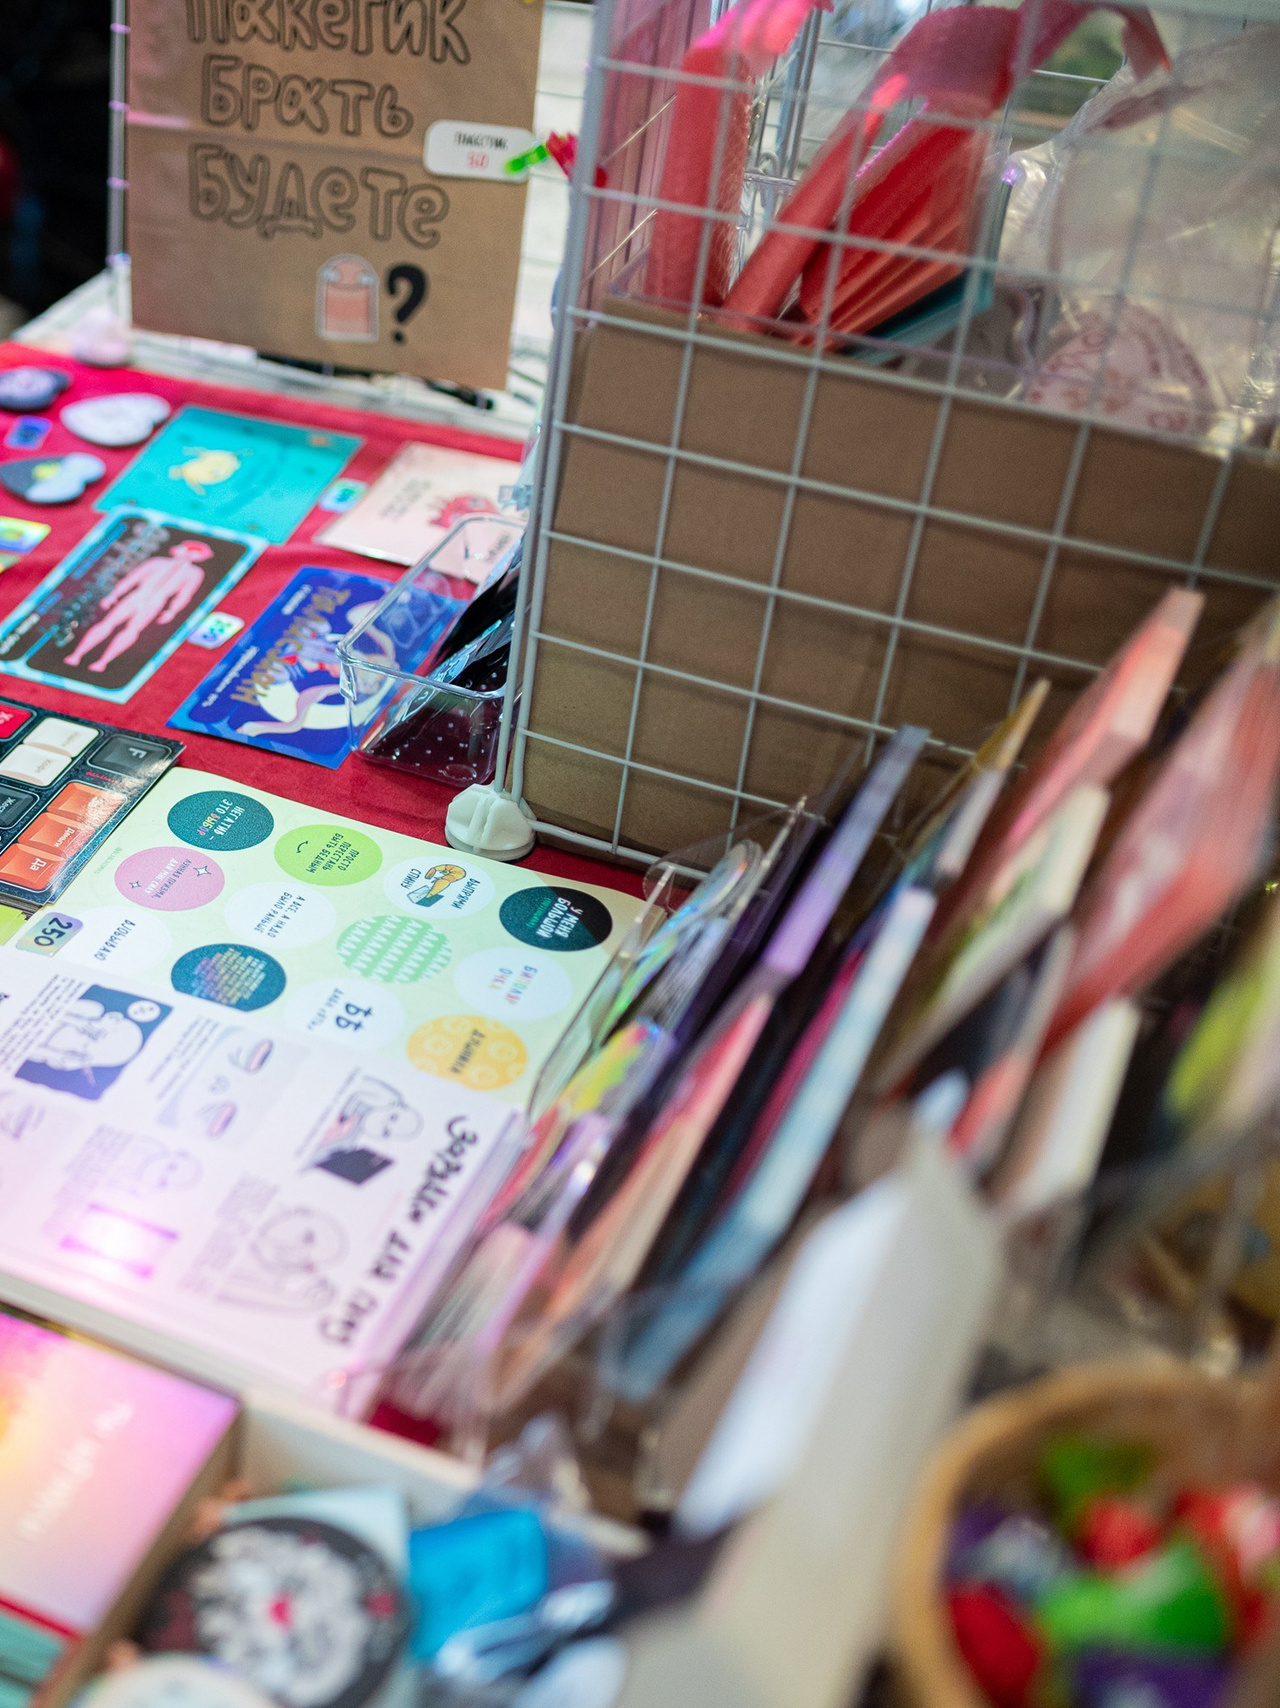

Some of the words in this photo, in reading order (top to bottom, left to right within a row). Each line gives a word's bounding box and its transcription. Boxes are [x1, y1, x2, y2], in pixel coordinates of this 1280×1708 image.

[125, 746, 147, 758] F
[213, 798, 234, 814] ЭТО
[194, 812, 221, 835] ВЫБОР
[212, 806, 246, 835] НЕГАТИВ
[51, 827, 76, 847] Деньги
[324, 832, 345, 849] БЫТЬ
[27, 857, 47, 872] Да
[162, 857, 181, 872] ДАЙ
[305, 848, 331, 873] БЕДНЫМ
[319, 841, 352, 871] ПЕРЕСТАНЬ
[336, 848, 360, 871] ПРОСТО
[153, 870, 170, 881] МНЕ
[170, 858, 194, 878] ЛУННАЯ
[397, 867, 423, 889] СПИНУ
[141, 879, 161, 895] СИЛУ
[149, 876, 177, 900] ПРИЗМА,
[449, 877, 481, 909] ВЫПРЯМИ
[272, 891, 294, 909] БЫЛО
[568, 905, 584, 915] У
[252, 908, 279, 932] РАНЬШЕ
[265, 919, 287, 937] НАДО
[534, 896, 572, 938] БОЛЬШОЙ
[553, 912, 581, 938] МЕНЯ
[33, 916, 73, 948] 250
[485, 966, 513, 990] ОЧКА
[501, 965, 537, 1004] БИПОЛЯР
[446, 1028, 487, 1074] ДУШНИЛА
